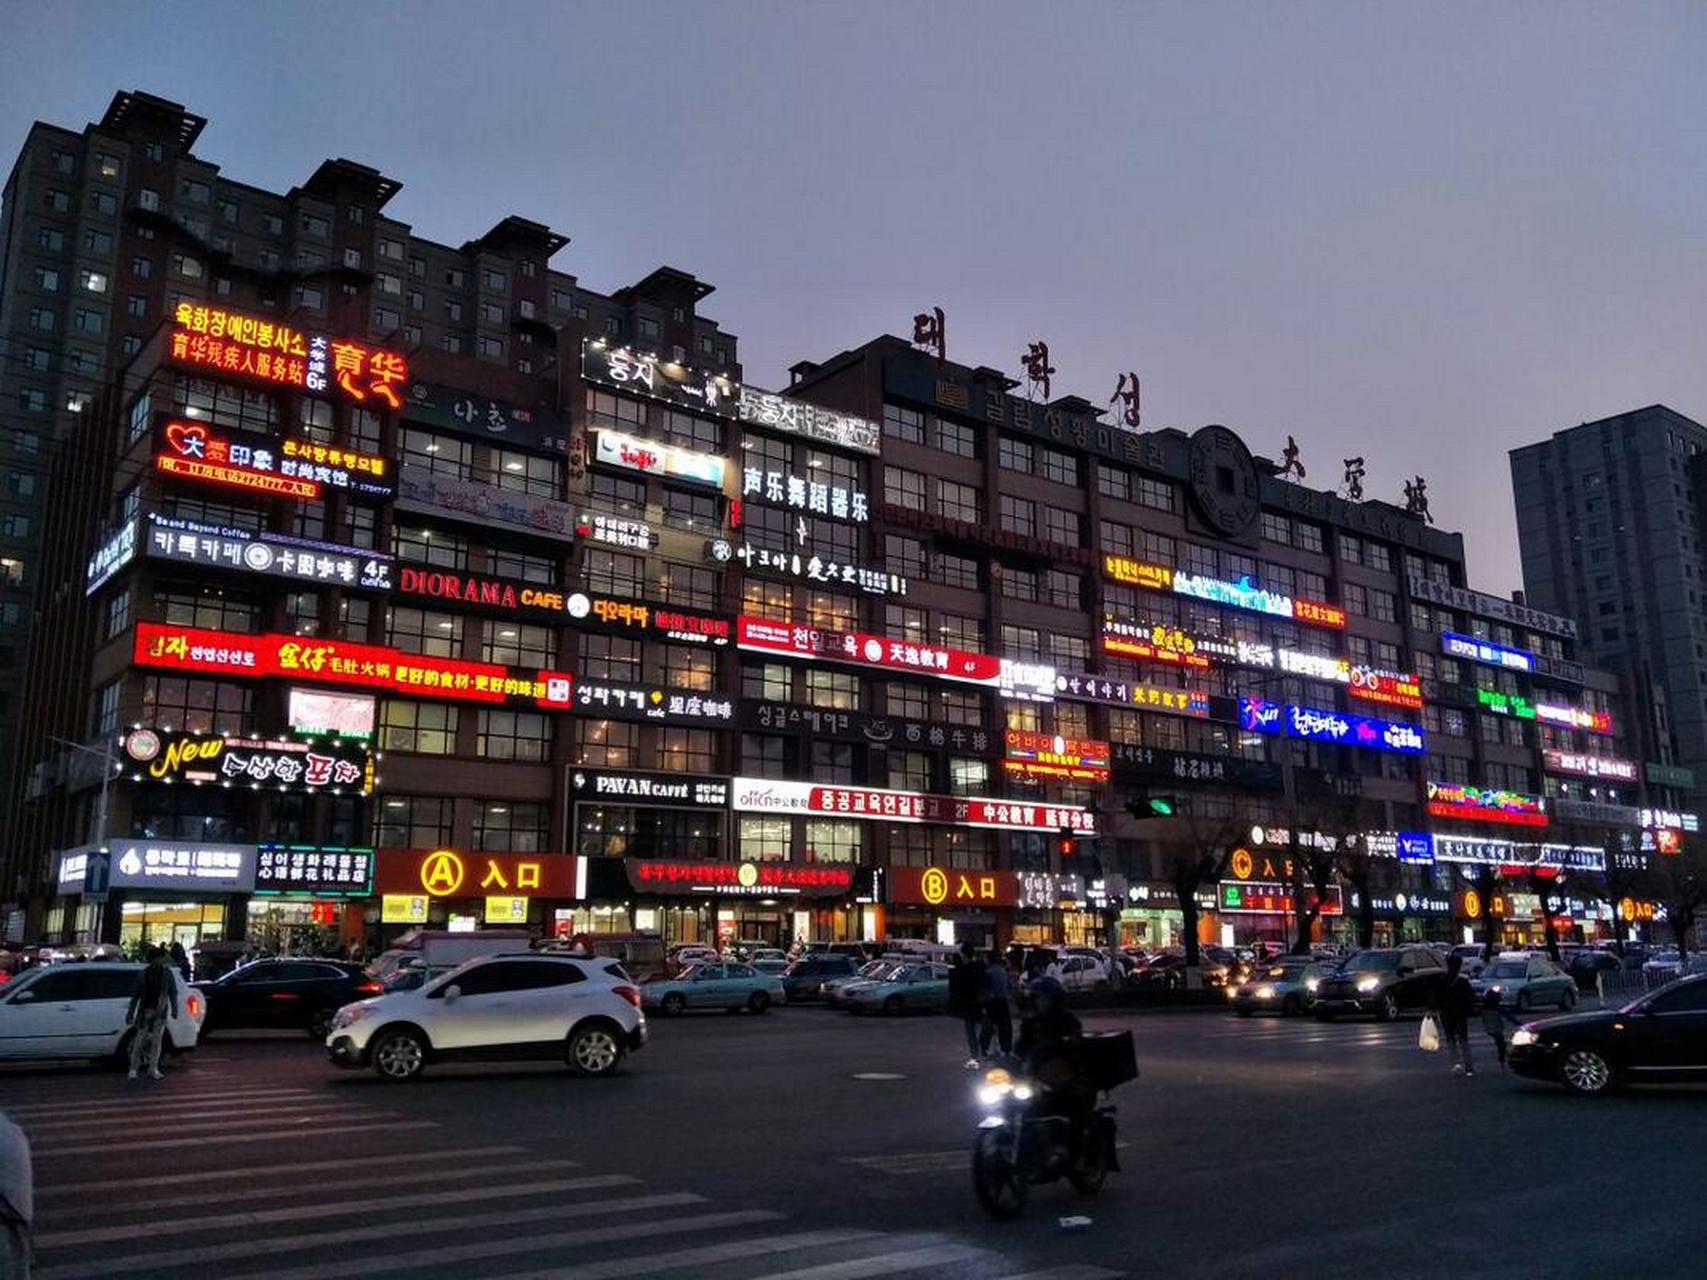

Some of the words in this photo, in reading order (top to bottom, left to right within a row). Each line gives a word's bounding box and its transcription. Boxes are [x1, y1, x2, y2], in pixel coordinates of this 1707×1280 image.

[172, 332, 303, 385] 育华残疾人服务站
[306, 372, 327, 391] 6F
[365, 559, 388, 578] 4F
[400, 568, 518, 609] DIORAMA
[521, 589, 563, 611] CAFE
[151, 737, 226, 778] New
[596, 776, 651, 796] PAVAN
[956, 802, 968, 817] 2F
[983, 801, 1035, 826] 中公教育
[480, 859, 541, 890] 入口
[957, 875, 996, 900] 入口
